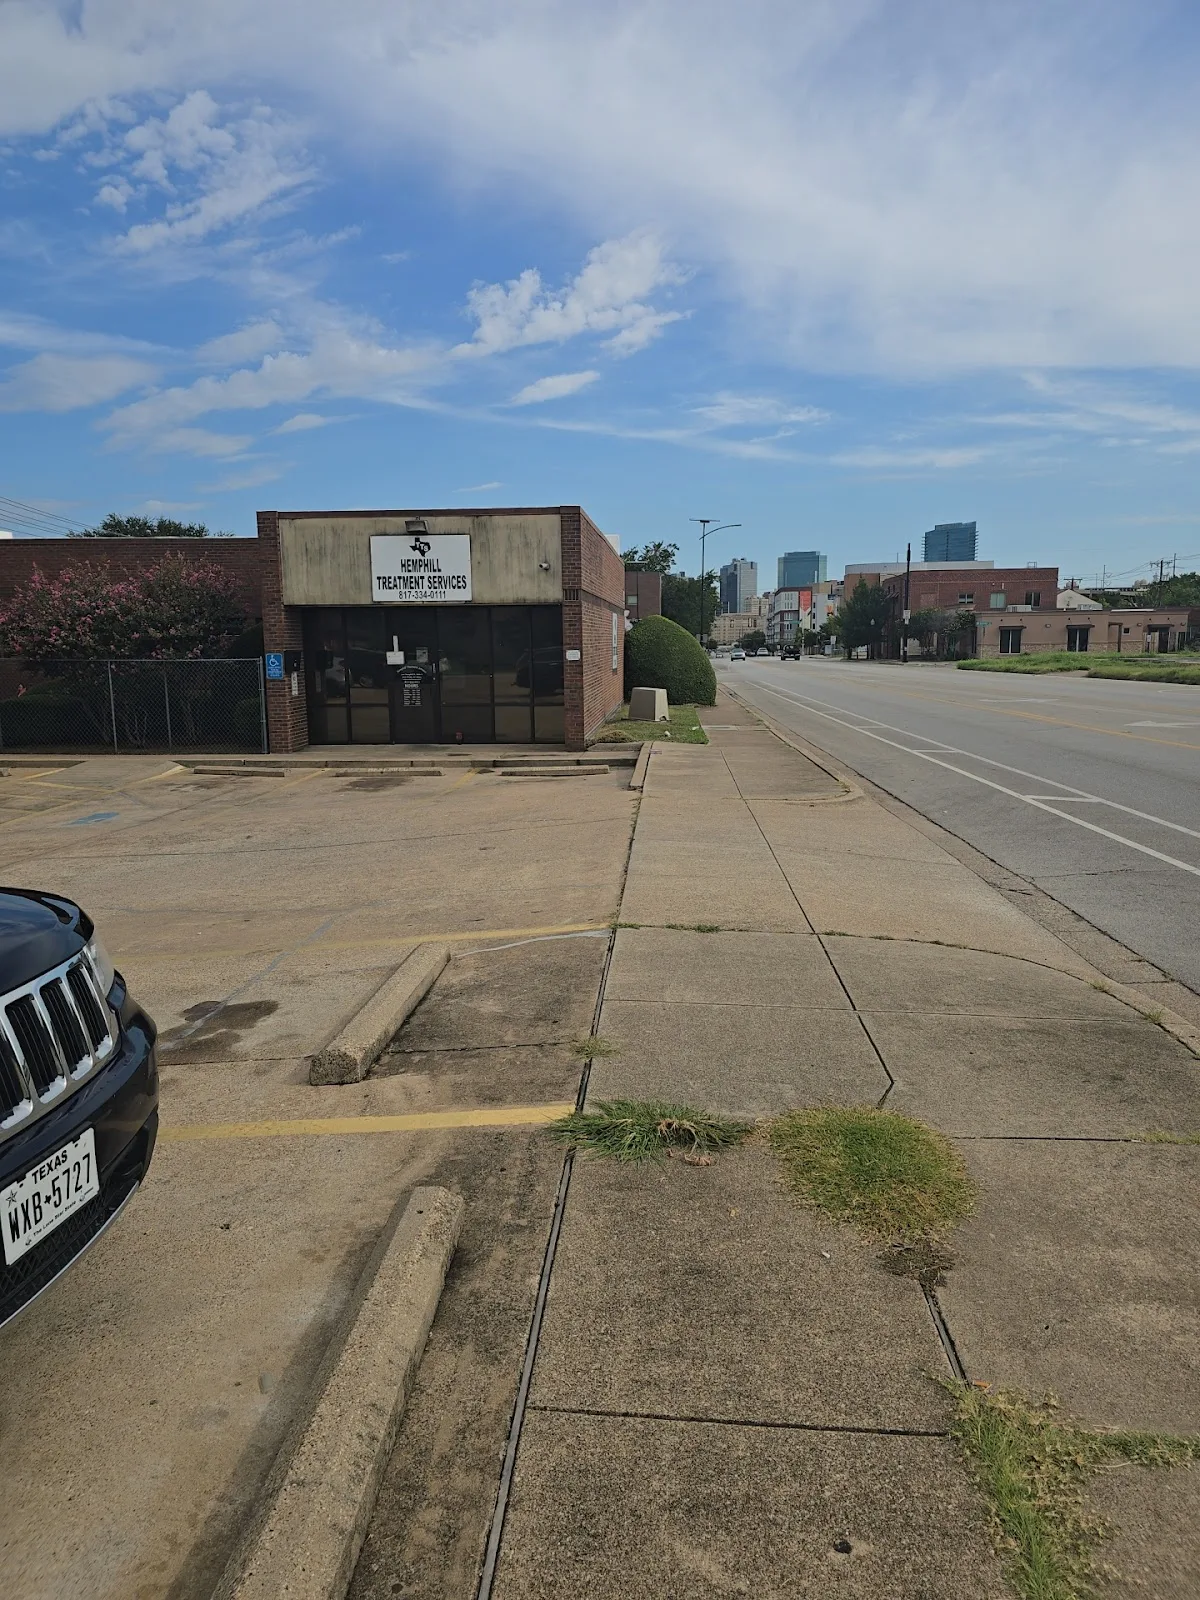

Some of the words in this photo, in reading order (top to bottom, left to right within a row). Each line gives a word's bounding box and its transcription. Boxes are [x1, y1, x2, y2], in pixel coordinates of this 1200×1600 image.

[415, 541, 429, 552] TTS
[400, 559, 442, 573] HEMPHILL
[376, 575, 425, 590] TREATMENT
[427, 575, 467, 590] SERVICES
[398, 590, 446, 600] 817-334-0111
[32, 1149, 68, 1184] TEXAS
